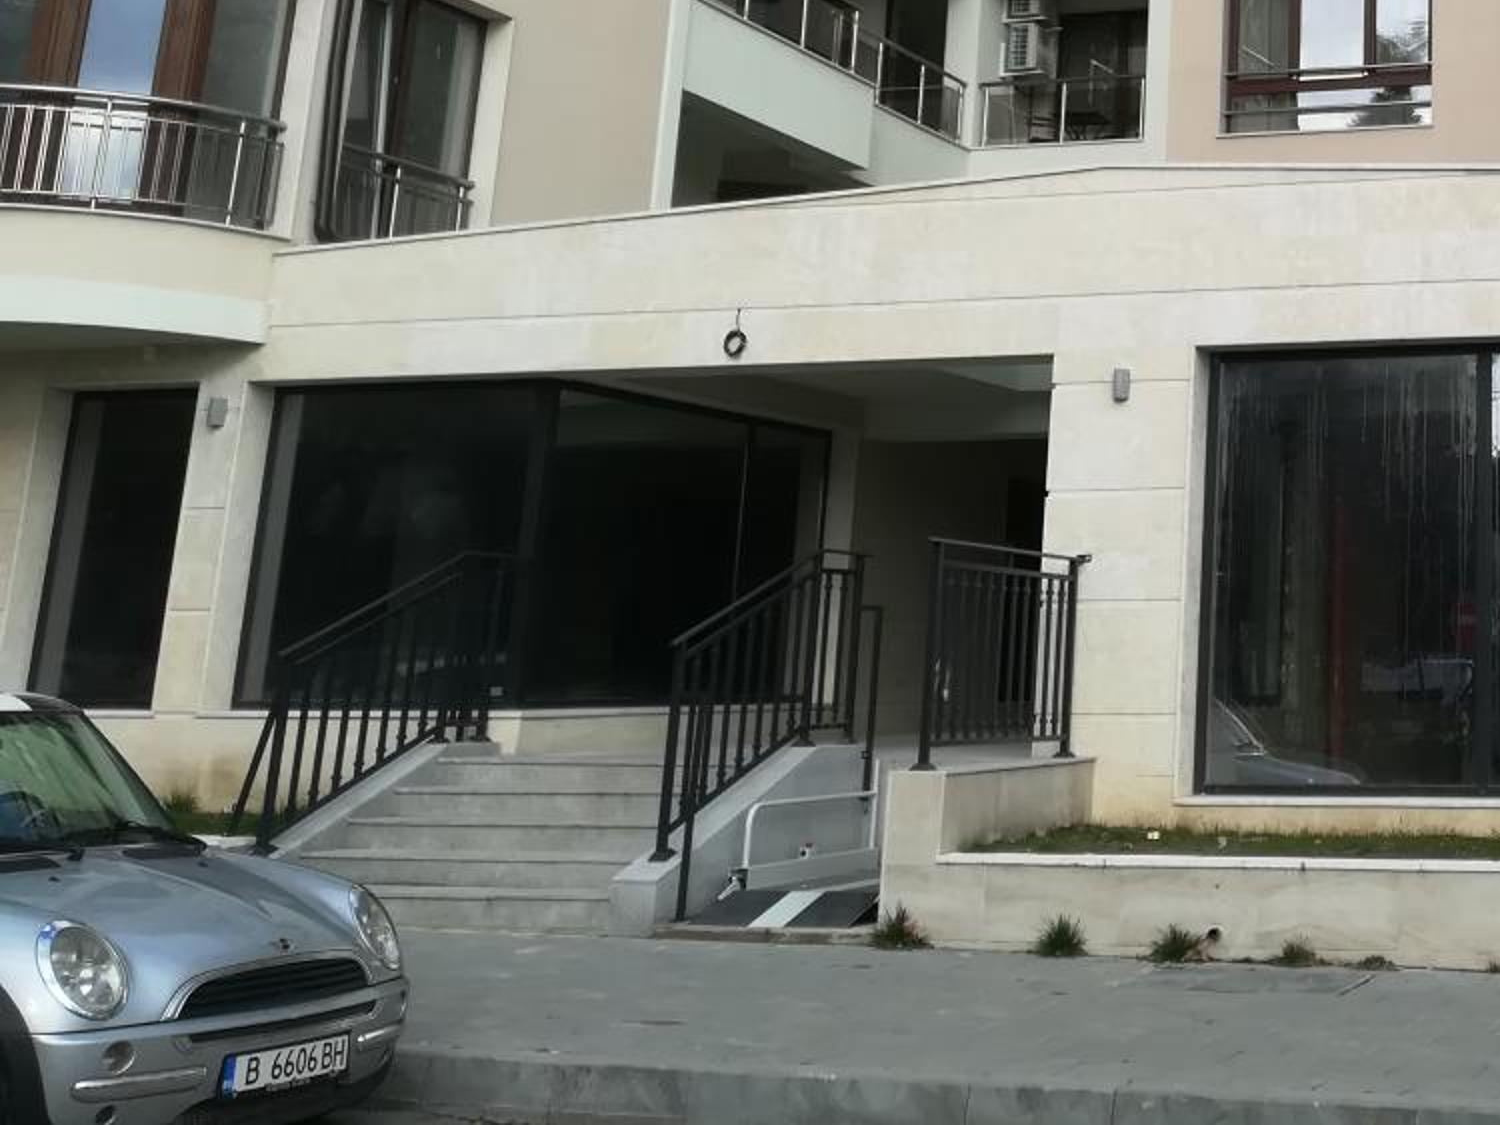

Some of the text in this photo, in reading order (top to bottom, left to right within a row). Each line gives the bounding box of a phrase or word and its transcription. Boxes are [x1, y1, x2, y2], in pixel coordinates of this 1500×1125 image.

[245, 1056, 260, 1085] B
[271, 1044, 318, 1079] 6606
[321, 1038, 346, 1069] BH
